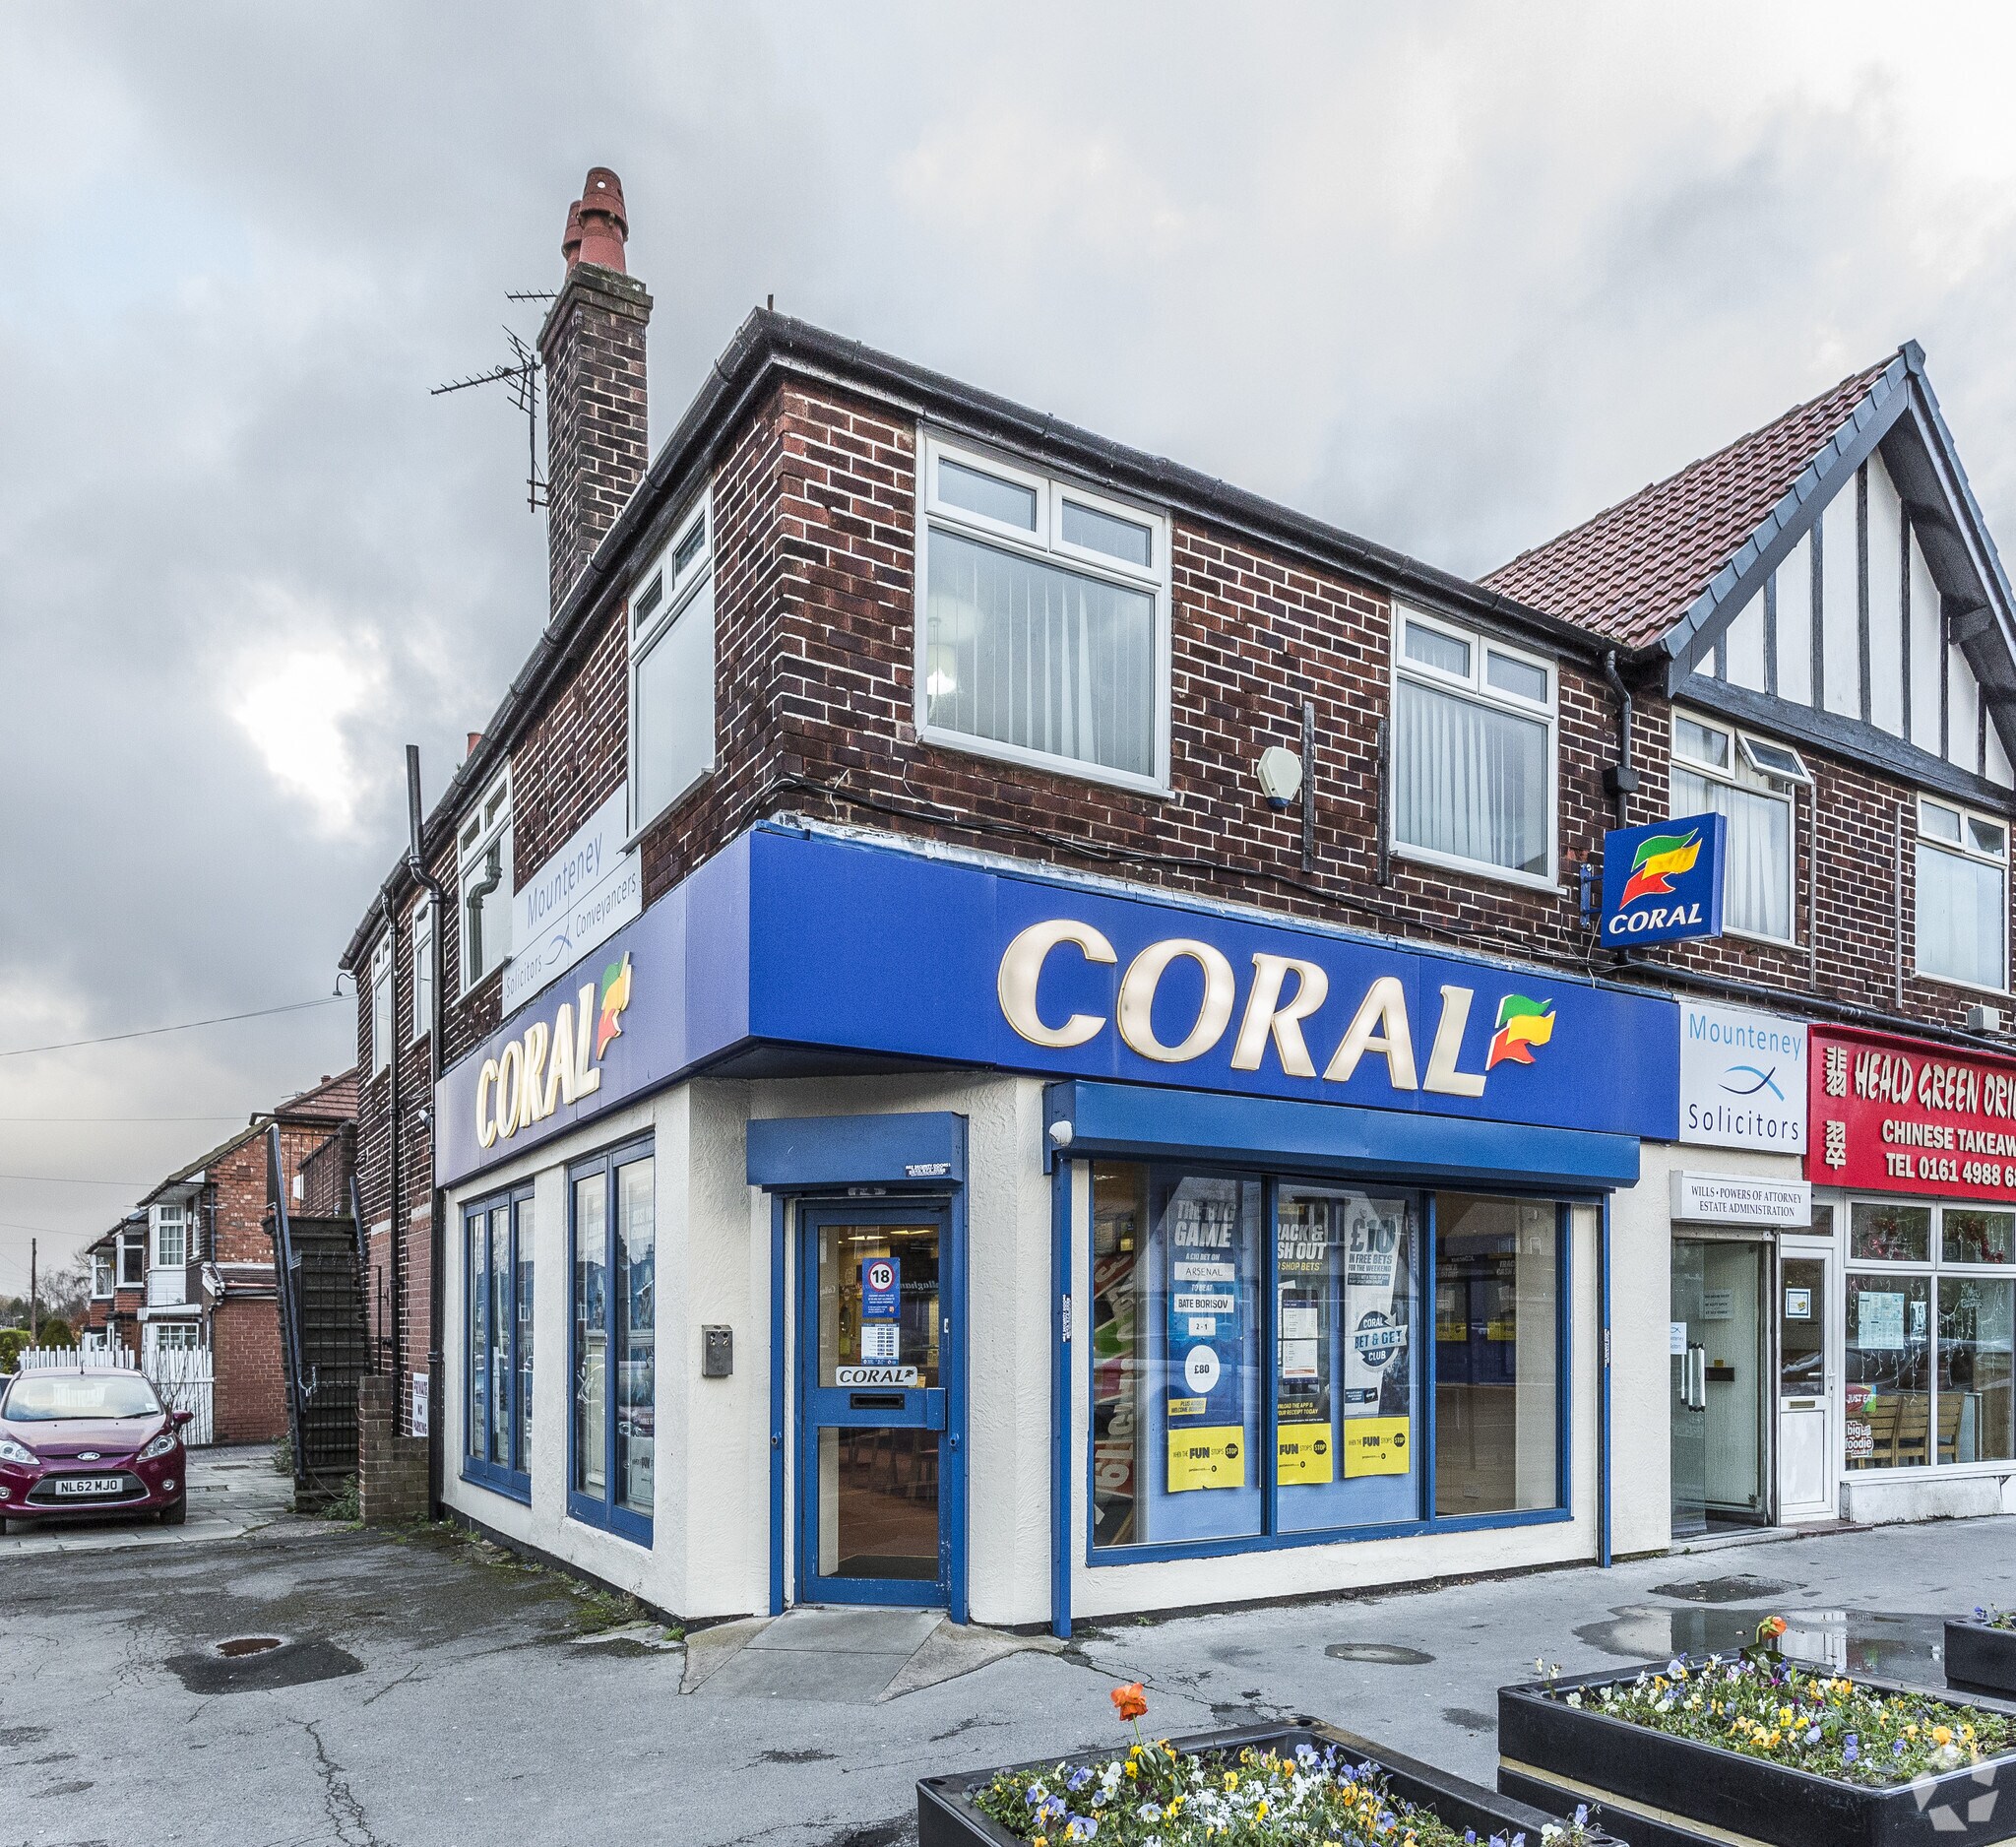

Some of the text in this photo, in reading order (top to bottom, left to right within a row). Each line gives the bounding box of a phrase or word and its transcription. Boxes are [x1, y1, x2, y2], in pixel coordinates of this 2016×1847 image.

[528, 832, 602, 928] Mounteney
[1608, 903, 1703, 934] CORAL
[506, 872, 637, 998] Solicitors Conveyancers
[997, 919, 1487, 1097] CORAL
[1689, 1013, 1801, 1061] Mounteney
[475, 983, 599, 1148] CORAL
[1855, 1051, 2016, 1119] HEALD GREEN DRI
[1688, 1103, 1798, 1140] Solicitors
[1882, 1118, 1954, 1150] CHINESE
[1886, 1152, 2016, 1187] TEL 0161 4988 6
[1691, 1185, 1802, 1204] WILLS POWERS OF ATTORNEY
[1177, 1200, 1203, 1220] THE
[1699, 1200, 1795, 1217] ESTATE ADMINISTRATION
[1174, 1221, 1233, 1248] GAME
[1311, 1224, 1324, 1242] &
[1350, 1219, 1396, 1253] £10
[1295, 1242, 1327, 1260] OUT
[1349, 1253, 1393, 1264] IN FREE BETS
[1185, 1267, 1224, 1277] ARSENAL
[1281, 1262, 1300, 1271] SHOP
[871, 1269, 890, 1284] 18
[1178, 1299, 1228, 1308] BATE BORISOV
[1362, 1316, 1384, 1328] CORAL
[1354, 1330, 1403, 1349] BET & GET
[1368, 1350, 1386, 1362] CLUB
[839, 1369, 905, 1383] CORAL
[1194, 1364, 1210, 1374] £80
[1847, 1394, 1875, 1403] JUST EAT
[1847, 1423, 1861, 1437] big
[1279, 1443, 1298, 1455] FUN
[1314, 1443, 1327, 1452] STOP
[1362, 1435, 1380, 1447] FUN
[1189, 1447, 1210, 1459] FUN
[61, 1480, 118, 1493] NL62 MJO
